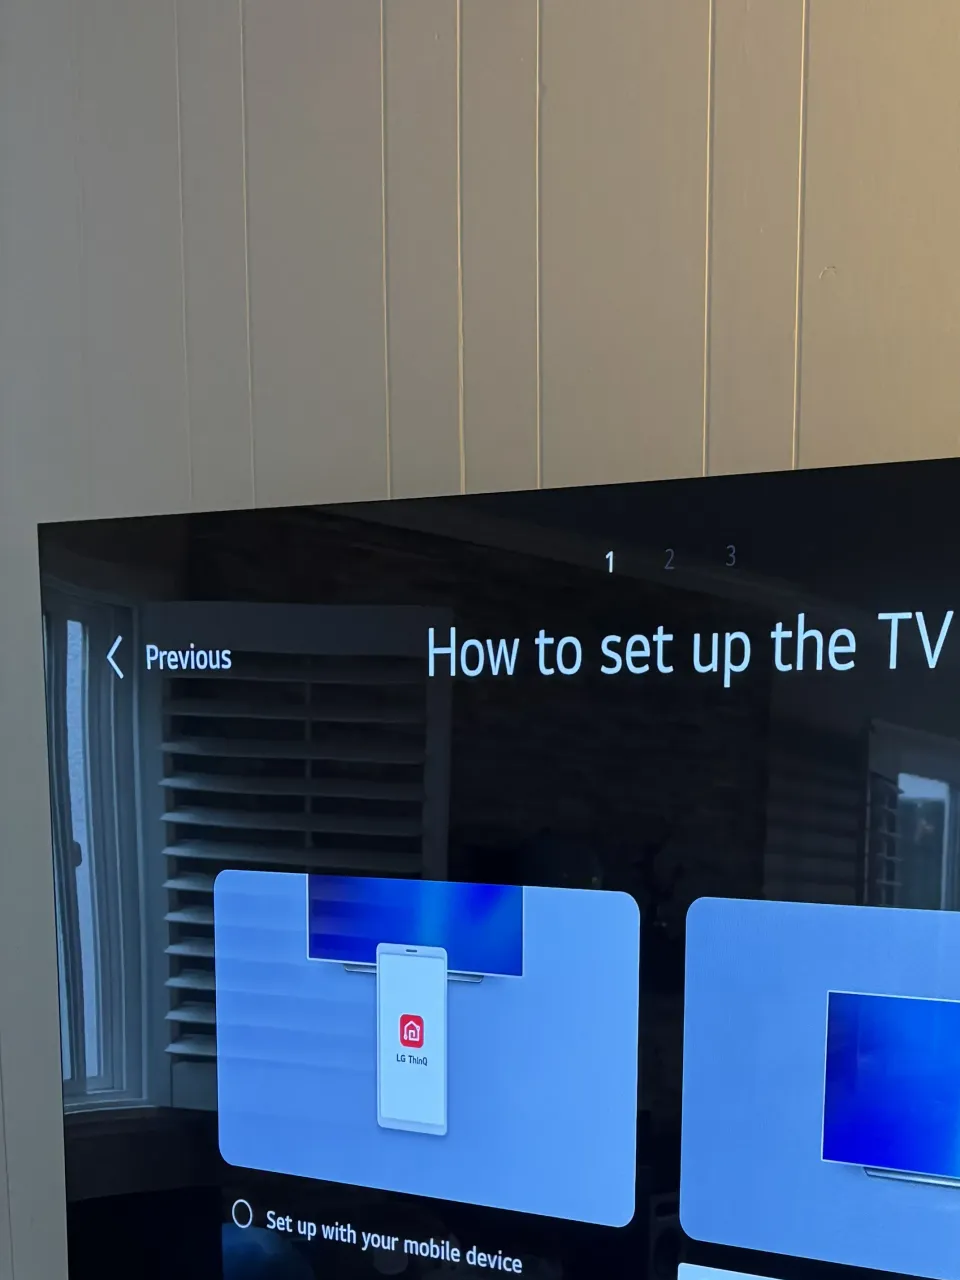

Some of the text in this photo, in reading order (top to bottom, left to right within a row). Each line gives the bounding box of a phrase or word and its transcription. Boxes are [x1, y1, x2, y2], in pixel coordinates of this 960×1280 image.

[605, 544, 736, 573] 1 2 3
[145, 643, 232, 673] Previous
[427, 611, 954, 687] How to set up the TV
[396, 1053, 428, 1066] LG ThinQ
[266, 1210, 523, 1273] Set up with your mobile device
